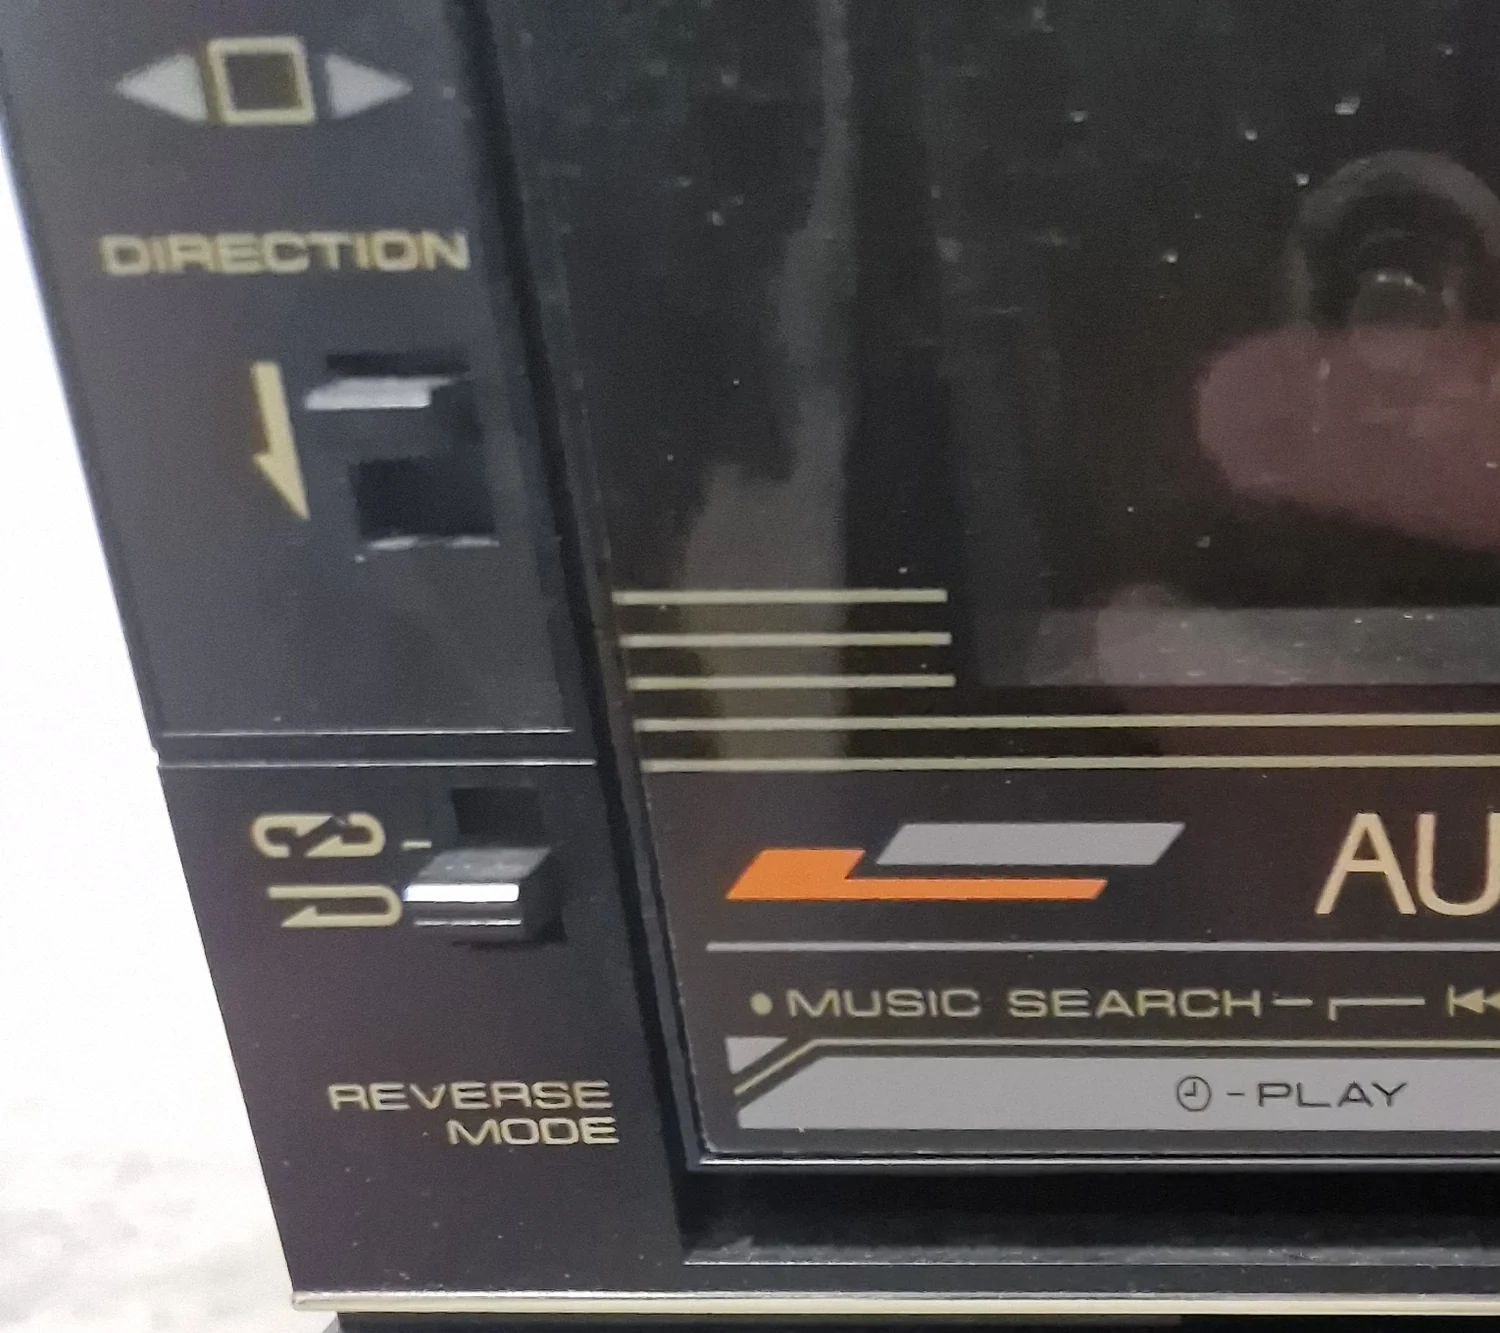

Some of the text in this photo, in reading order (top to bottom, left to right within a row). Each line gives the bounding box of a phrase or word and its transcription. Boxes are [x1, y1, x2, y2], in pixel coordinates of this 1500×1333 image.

[98, 230, 471, 275] DIRECTION
[785, 989, 1262, 1018] MUSIC SEARCH
[327, 1081, 613, 1110] REVERSE
[447, 1116, 620, 1145] MODE
